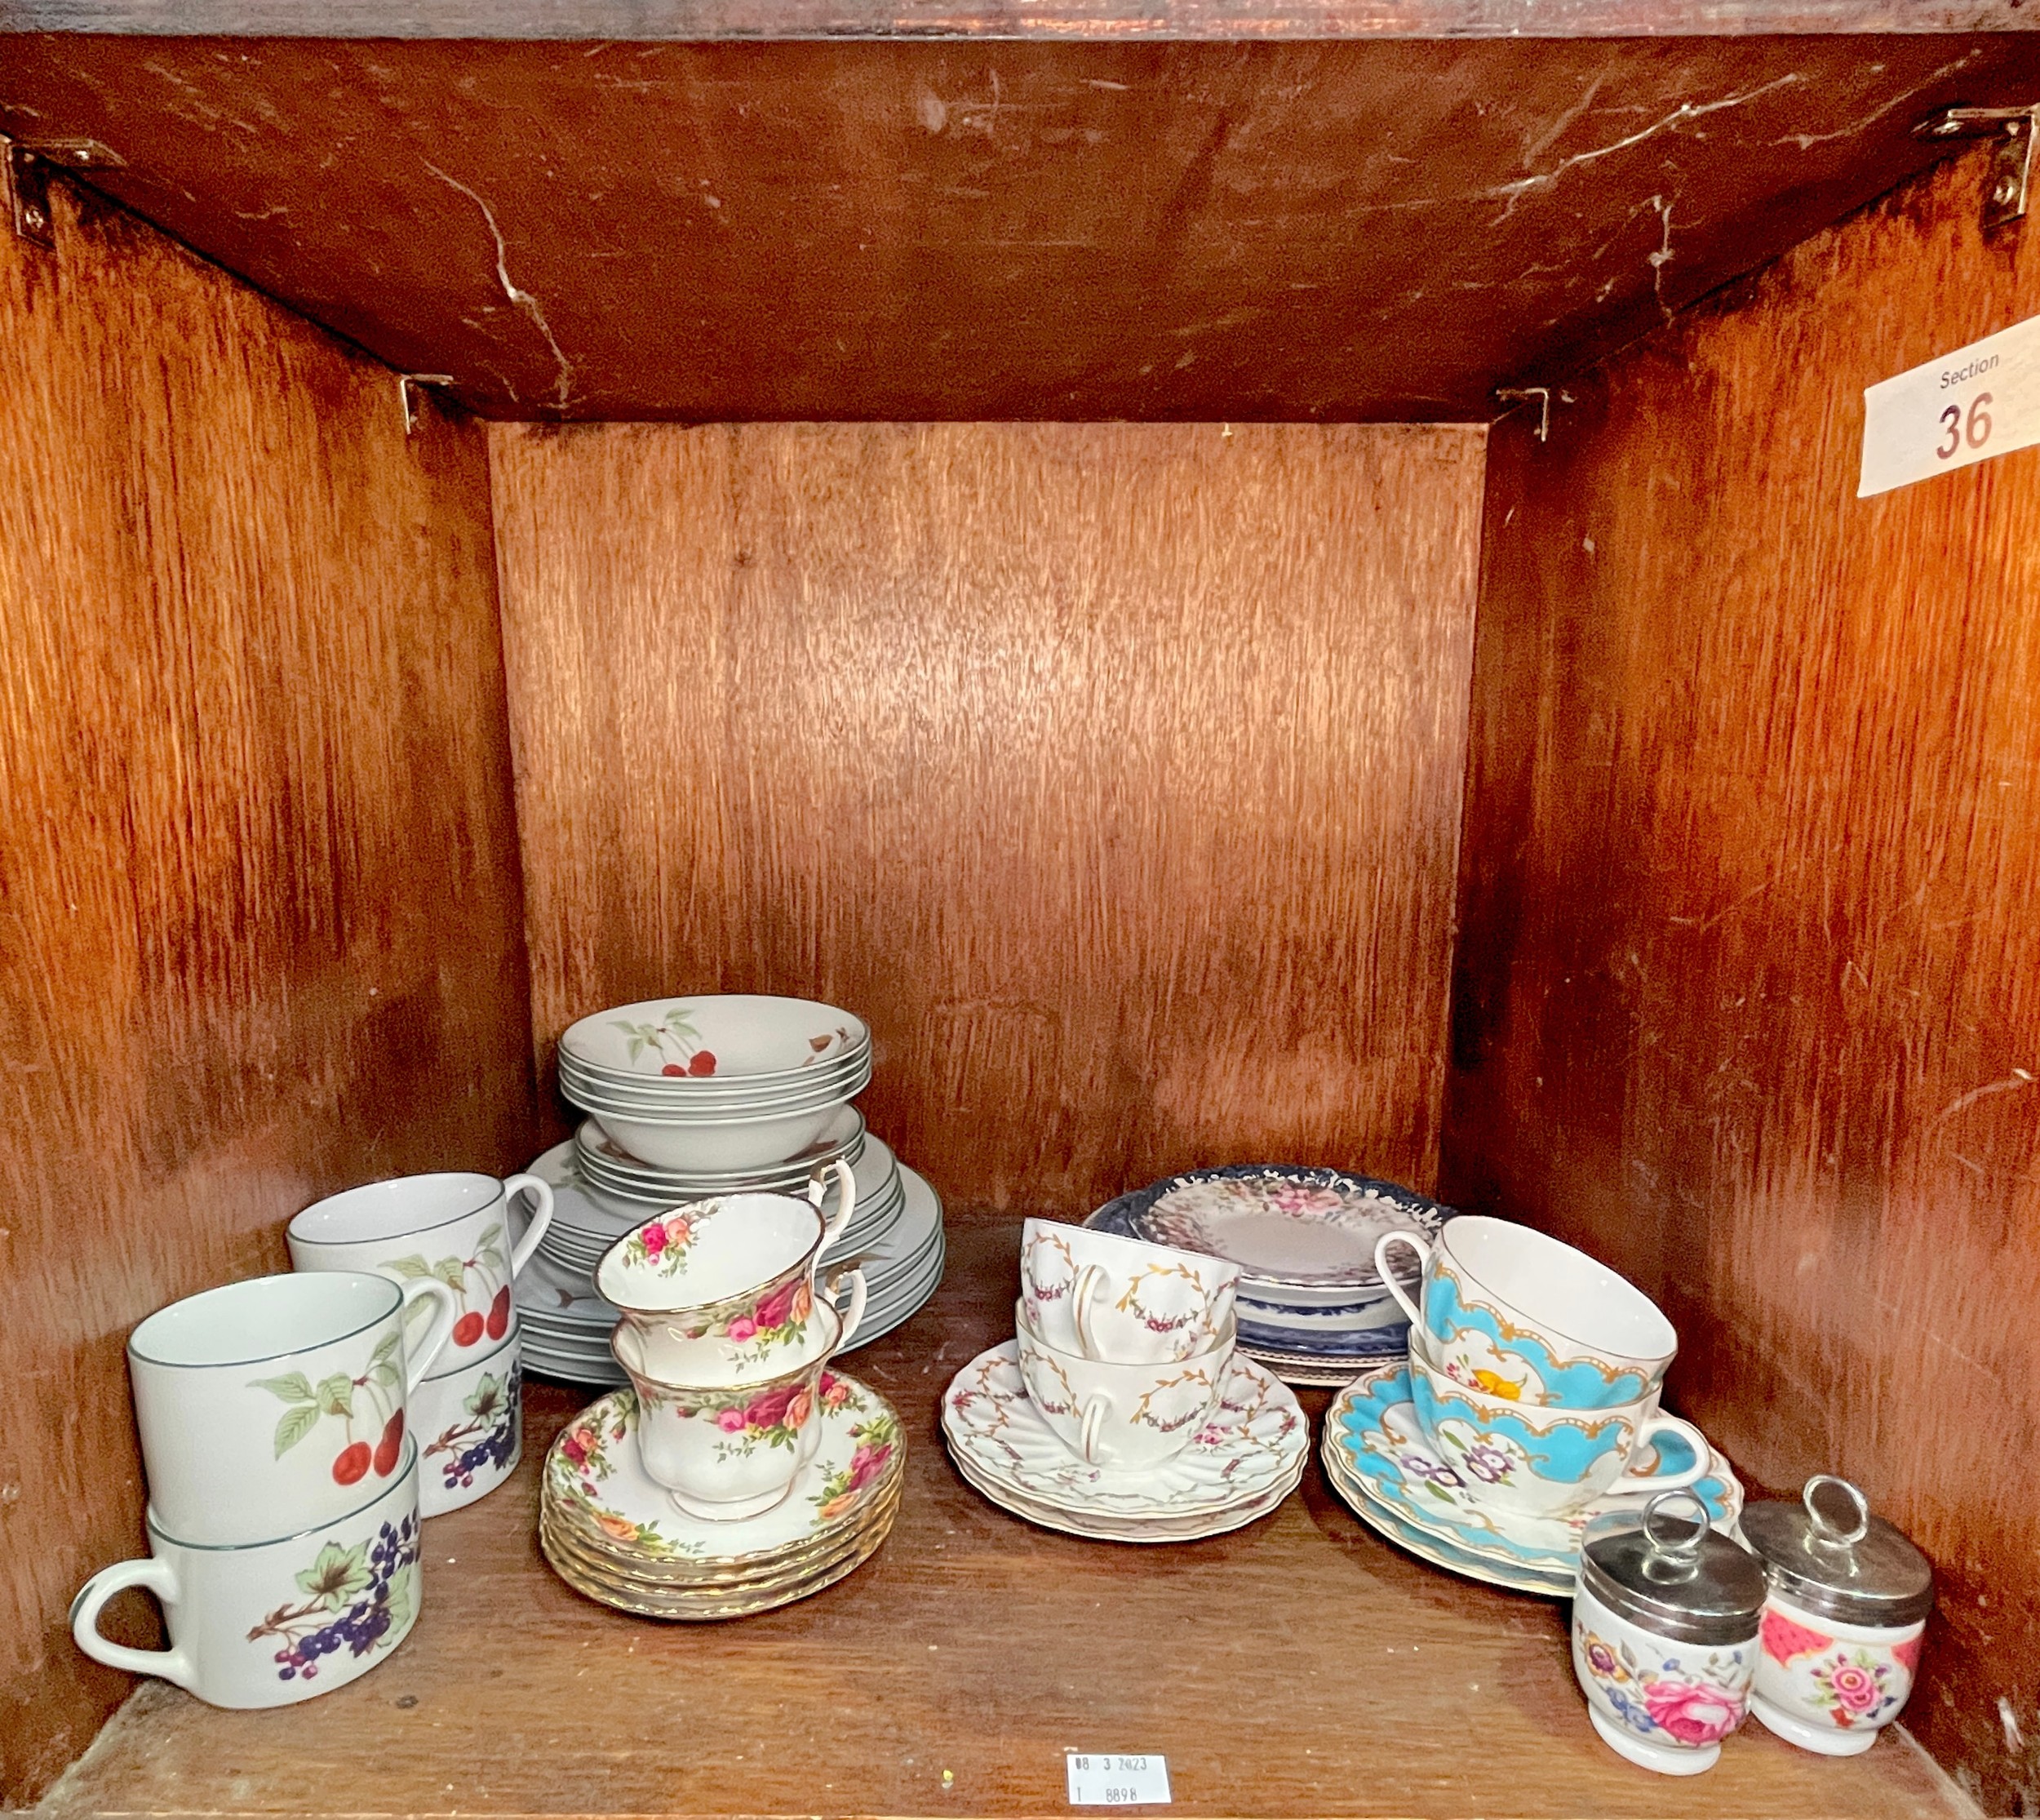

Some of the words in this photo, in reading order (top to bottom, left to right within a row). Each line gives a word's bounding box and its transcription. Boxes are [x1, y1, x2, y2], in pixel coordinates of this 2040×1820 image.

[1940, 354, 1999, 389] Section
[1936, 392, 1993, 460] 36
[1103, 1758, 1111, 1770] 3
[1118, 1757, 1147, 1771] 2023
[1106, 1787, 1138, 1802] 8898
